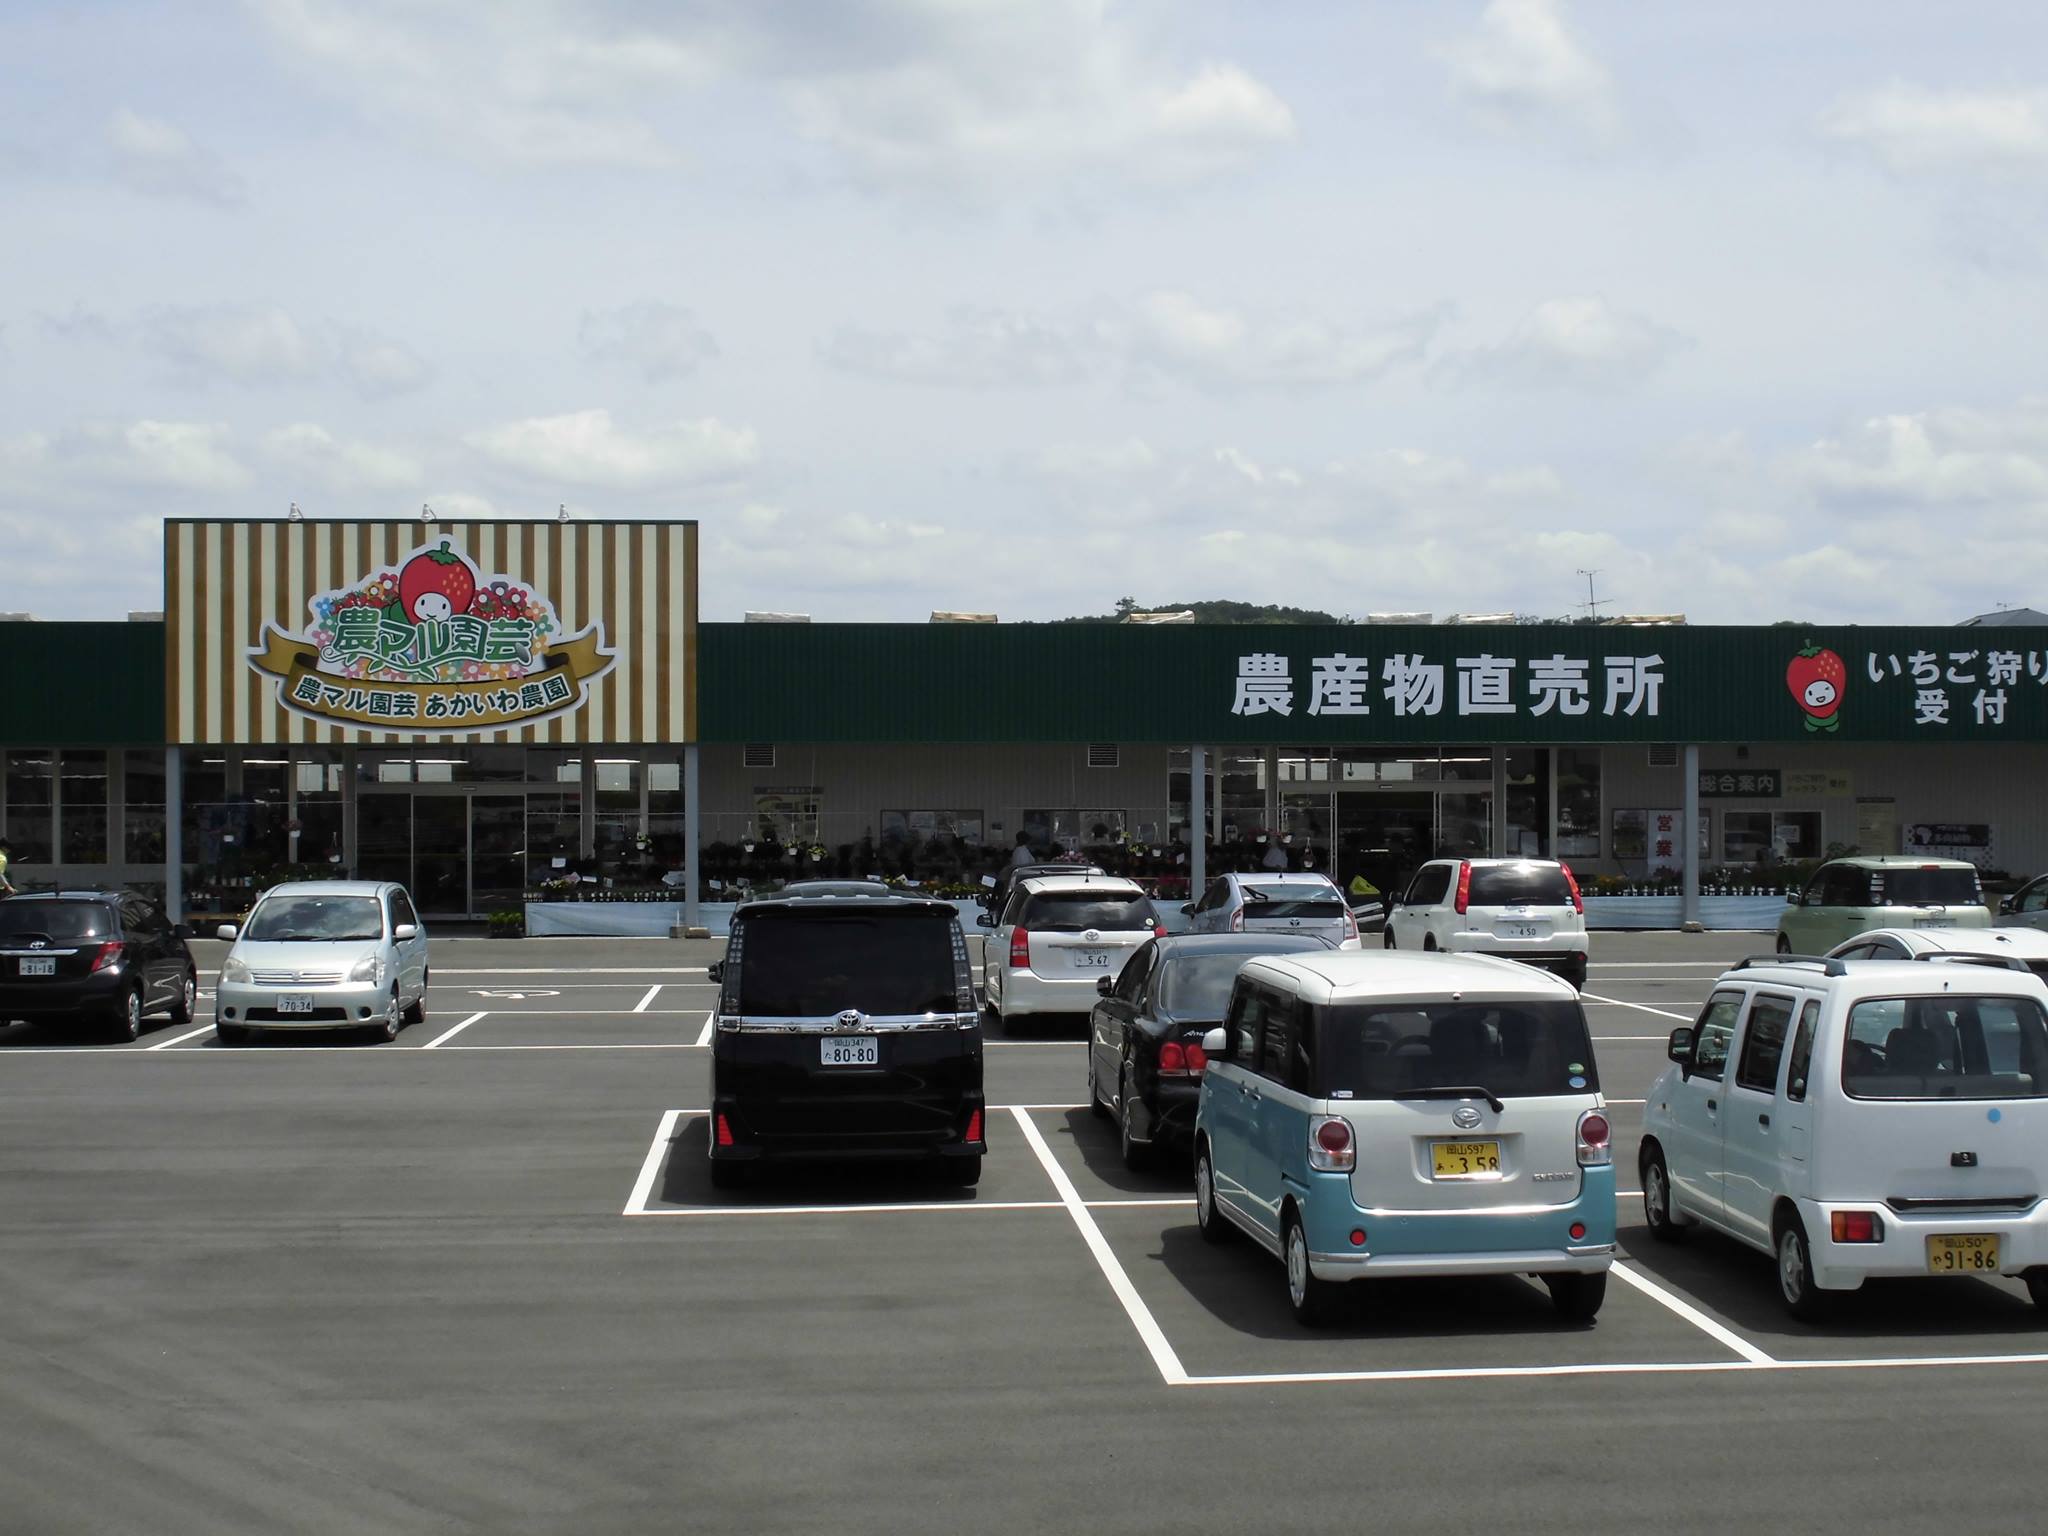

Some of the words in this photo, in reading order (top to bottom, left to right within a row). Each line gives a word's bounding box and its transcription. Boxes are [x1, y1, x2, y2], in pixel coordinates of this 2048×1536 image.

[334, 607, 535, 662] 農マル園芸
[295, 676, 417, 716] 農マル園芸
[425, 675, 570, 717] あかいわ農園
[1231, 653, 1665, 717] 農産物直売所
[1915, 688, 2007, 724] 受付
[1699, 775, 1774, 793] 総合案内
[834, 1048, 875, 1062] 80-80
[1944, 1250, 1995, 1269] 91-86
